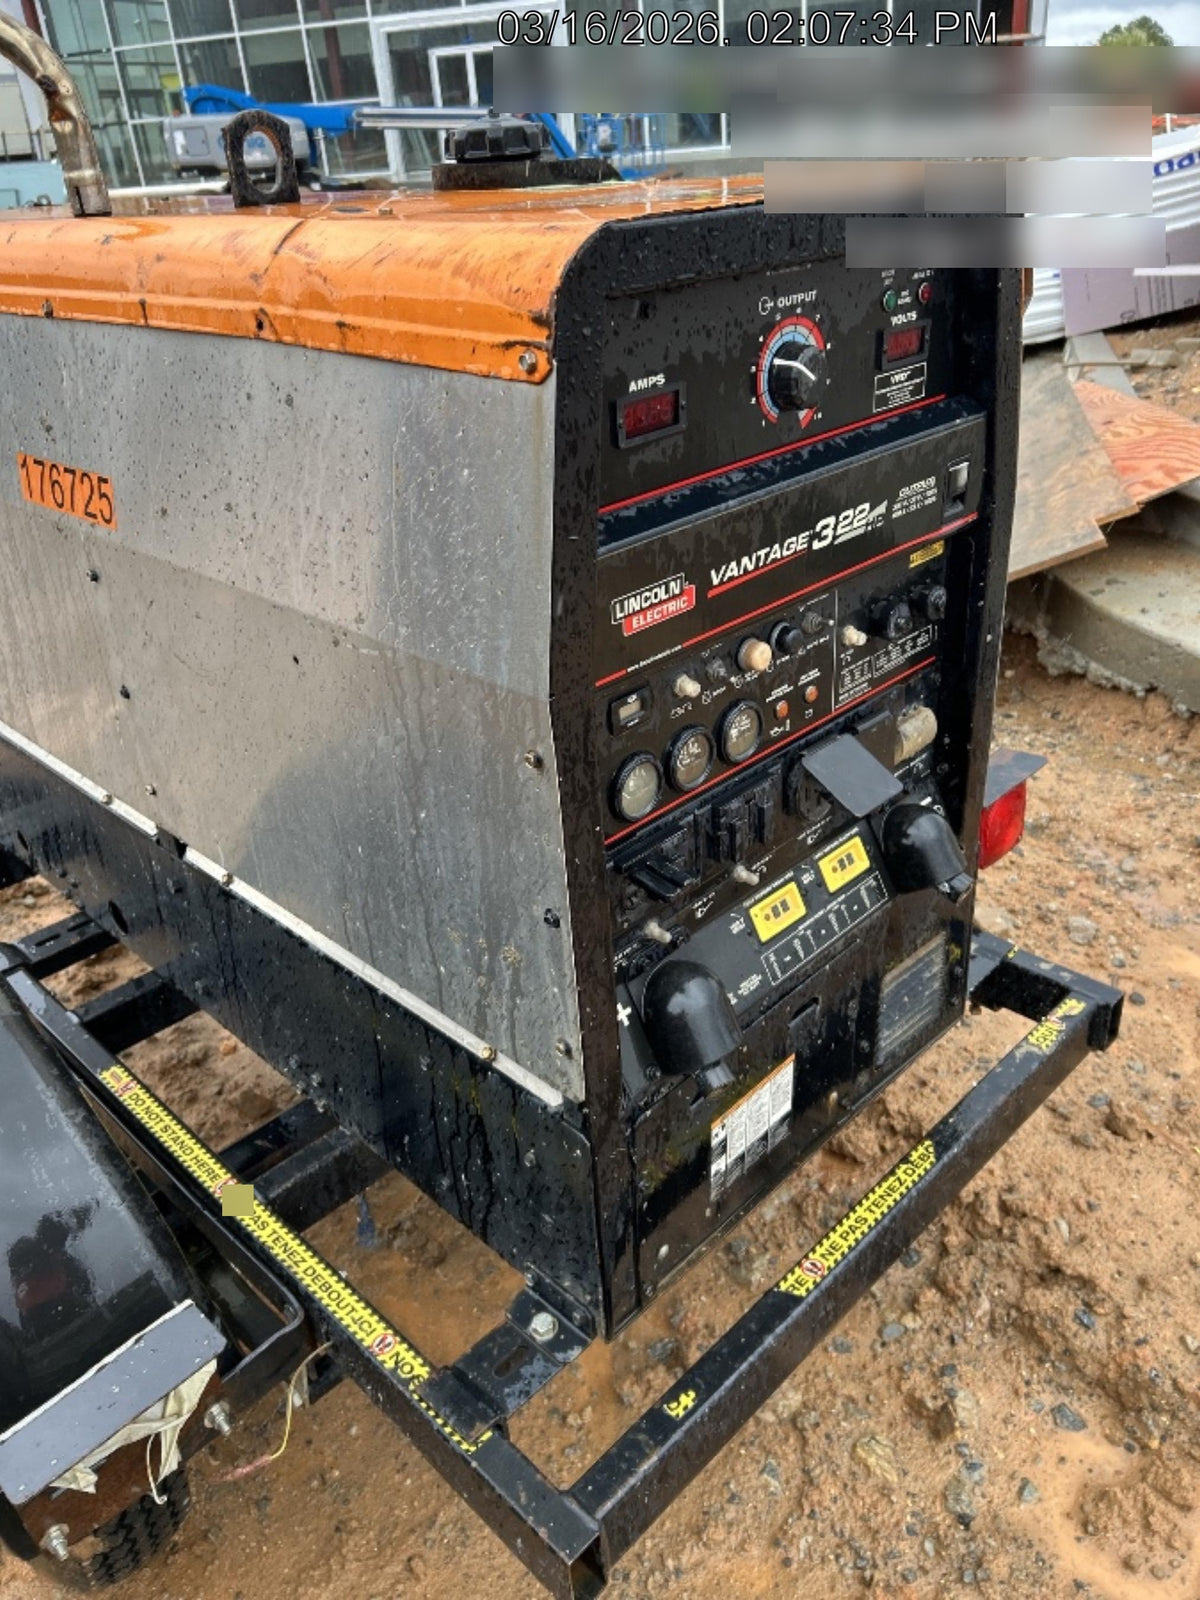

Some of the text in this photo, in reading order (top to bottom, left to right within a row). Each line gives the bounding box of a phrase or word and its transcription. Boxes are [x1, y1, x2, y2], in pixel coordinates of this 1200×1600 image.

[777, 290, 817, 307] OUTPUT
[890, 311, 917, 327] VOLTS
[629, 373, 666, 393] AMPS
[20, 454, 112, 525] 176725
[710, 502, 871, 586] VANTAGE 322
[615, 578, 681, 620] LINCOLN
[632, 597, 689, 629] ELECTRIC
[128, 1092, 222, 1183] DO NOT STAND HERE
[820, 1240, 843, 1261] NE
[840, 1215, 868, 1241] PAS
[864, 1176, 907, 1215] TENEZ
[248, 1210, 269, 1231] AS
[267, 1228, 308, 1268] TENEZ
[303, 1265, 358, 1316] DEBOUT
[389, 1351, 414, 1375] NO
